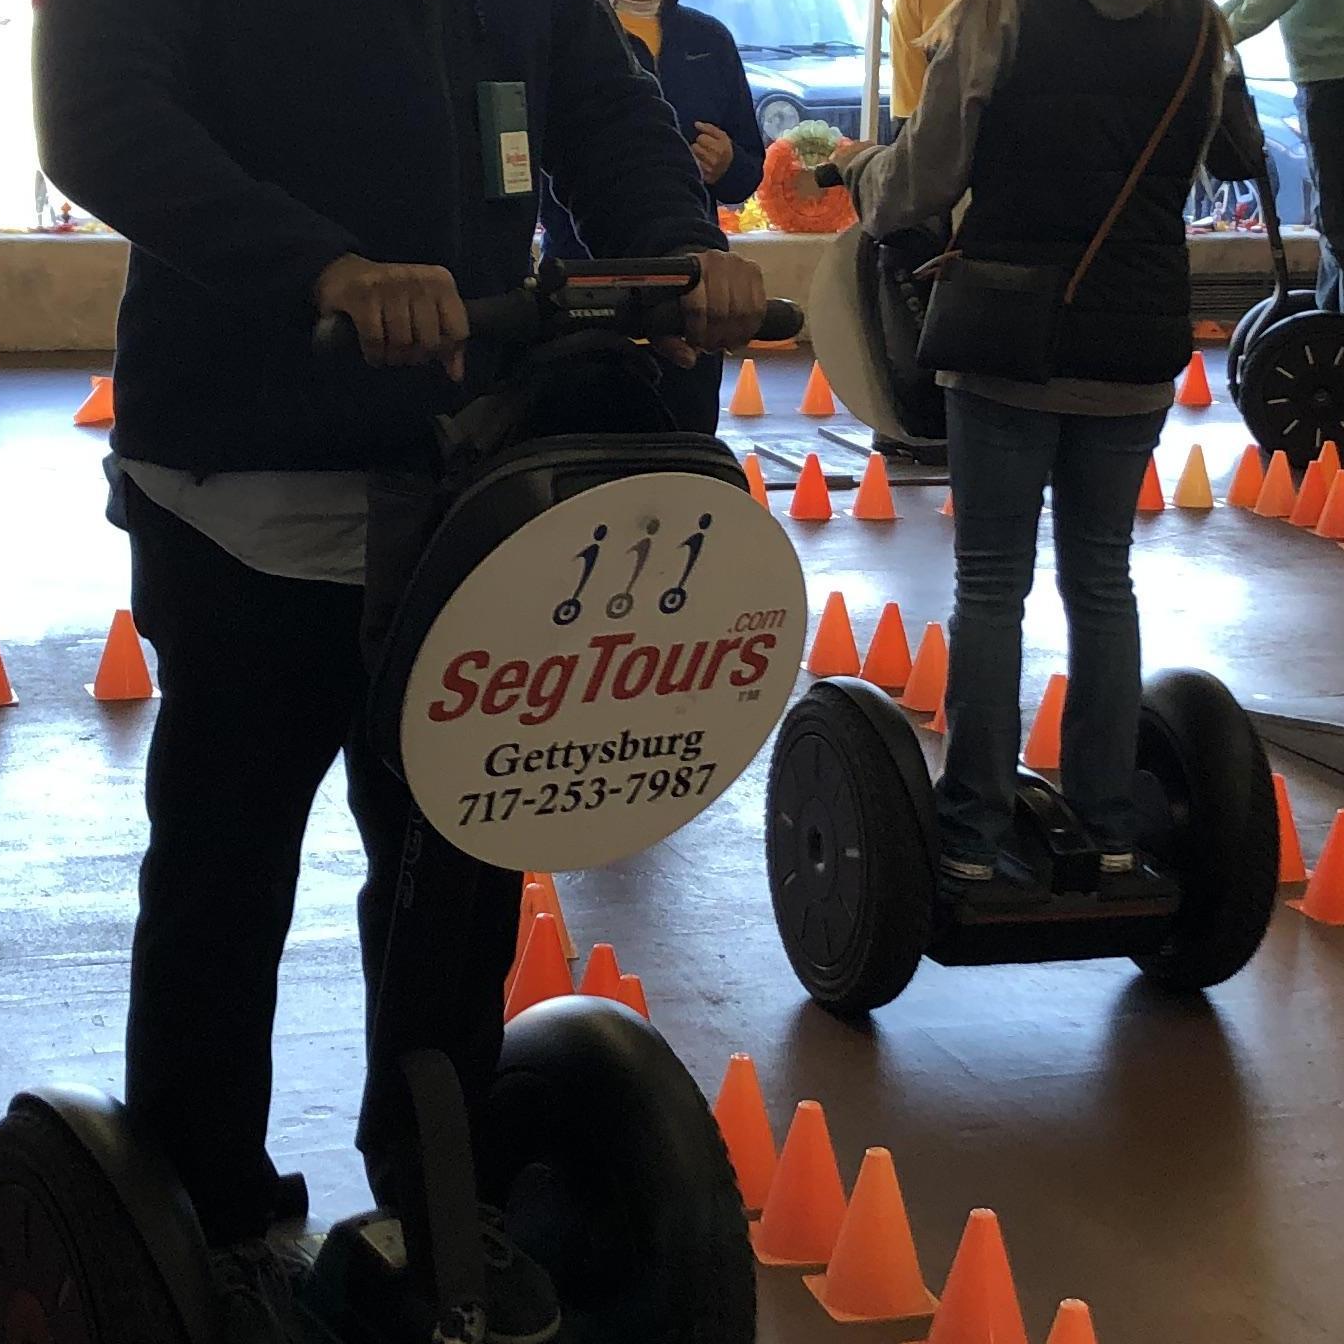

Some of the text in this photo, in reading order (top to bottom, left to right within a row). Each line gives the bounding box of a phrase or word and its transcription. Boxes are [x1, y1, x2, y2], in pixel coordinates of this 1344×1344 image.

[727, 609, 786, 632] .com
[485, 730, 704, 776] Gettysburg
[458, 763, 716, 826] 717-253-7987
